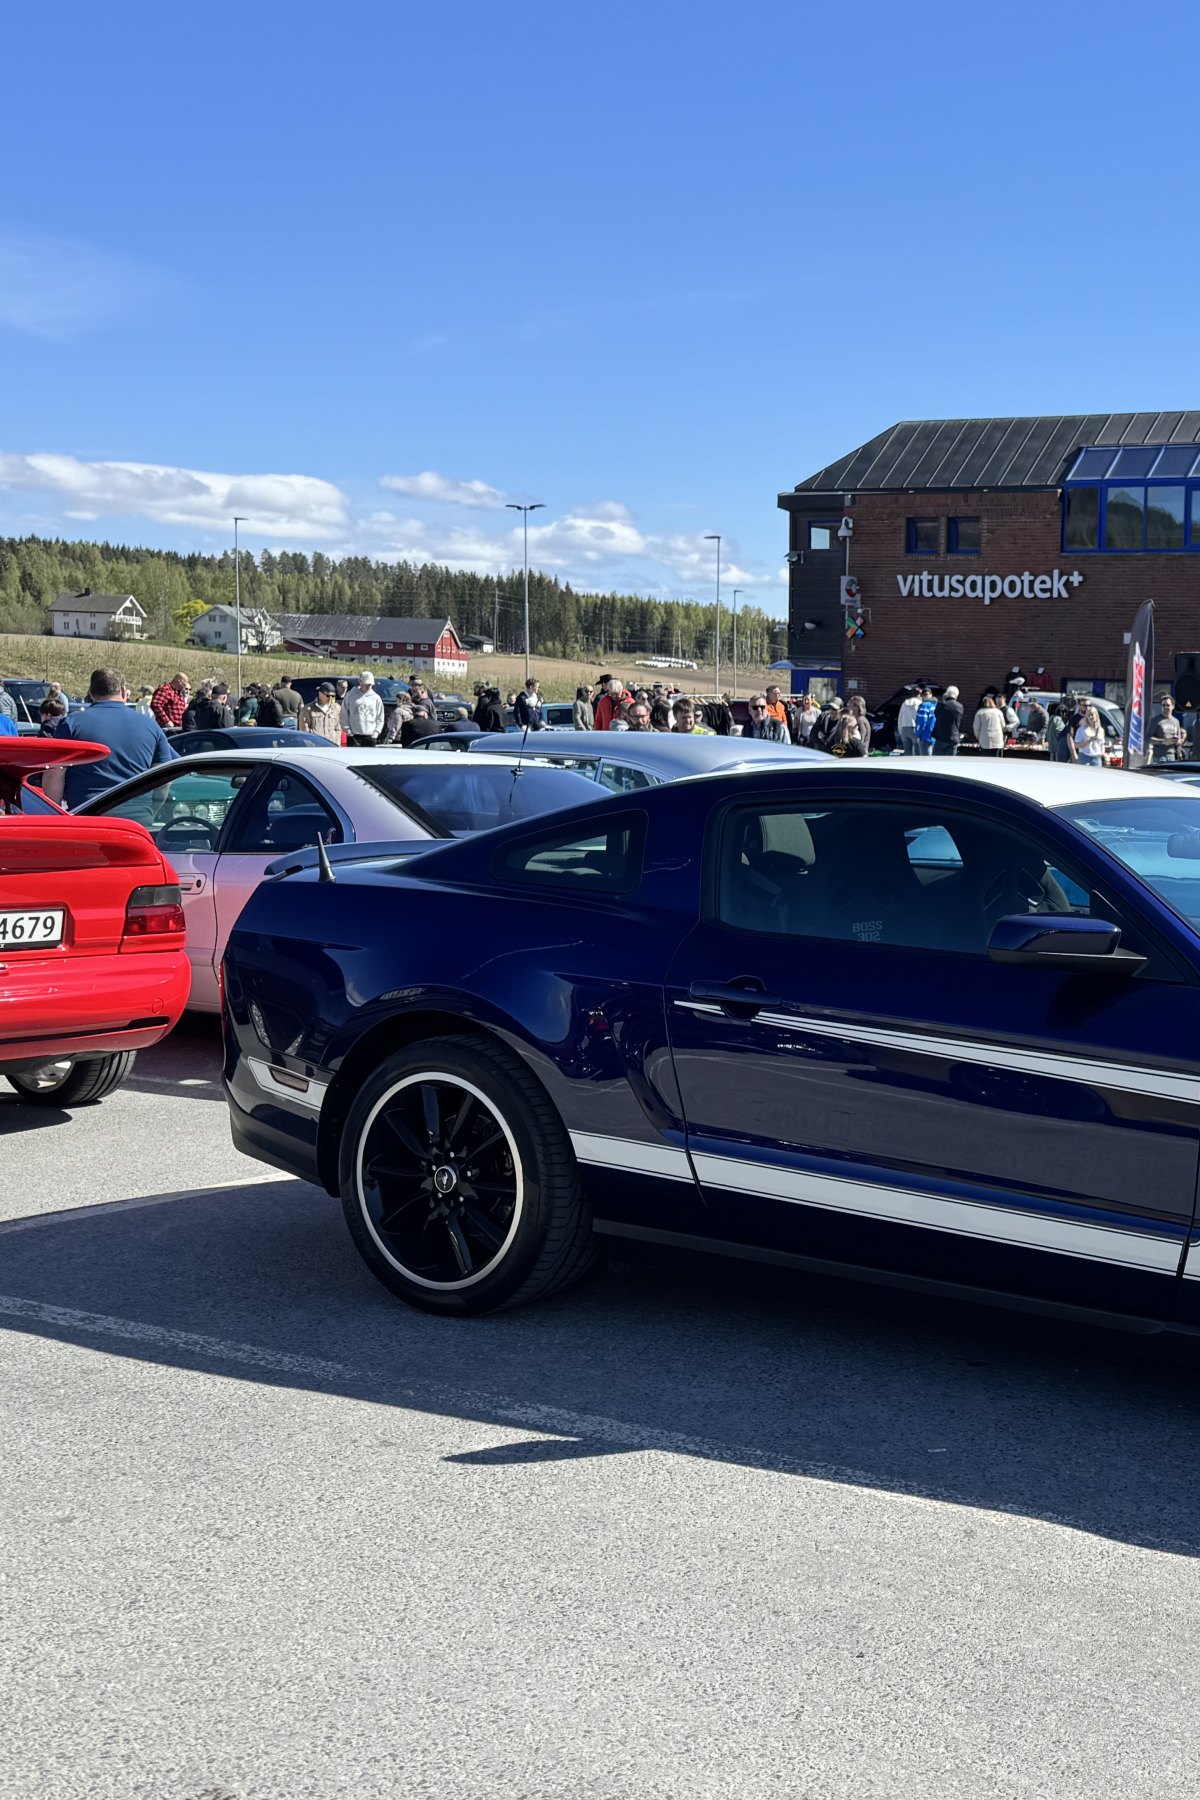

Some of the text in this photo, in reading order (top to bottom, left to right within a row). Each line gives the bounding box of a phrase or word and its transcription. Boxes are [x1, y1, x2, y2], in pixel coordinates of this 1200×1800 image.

[0, 915, 56, 940] 4679
[852, 921, 883, 933] BOSS
[857, 931, 881, 942] 302
